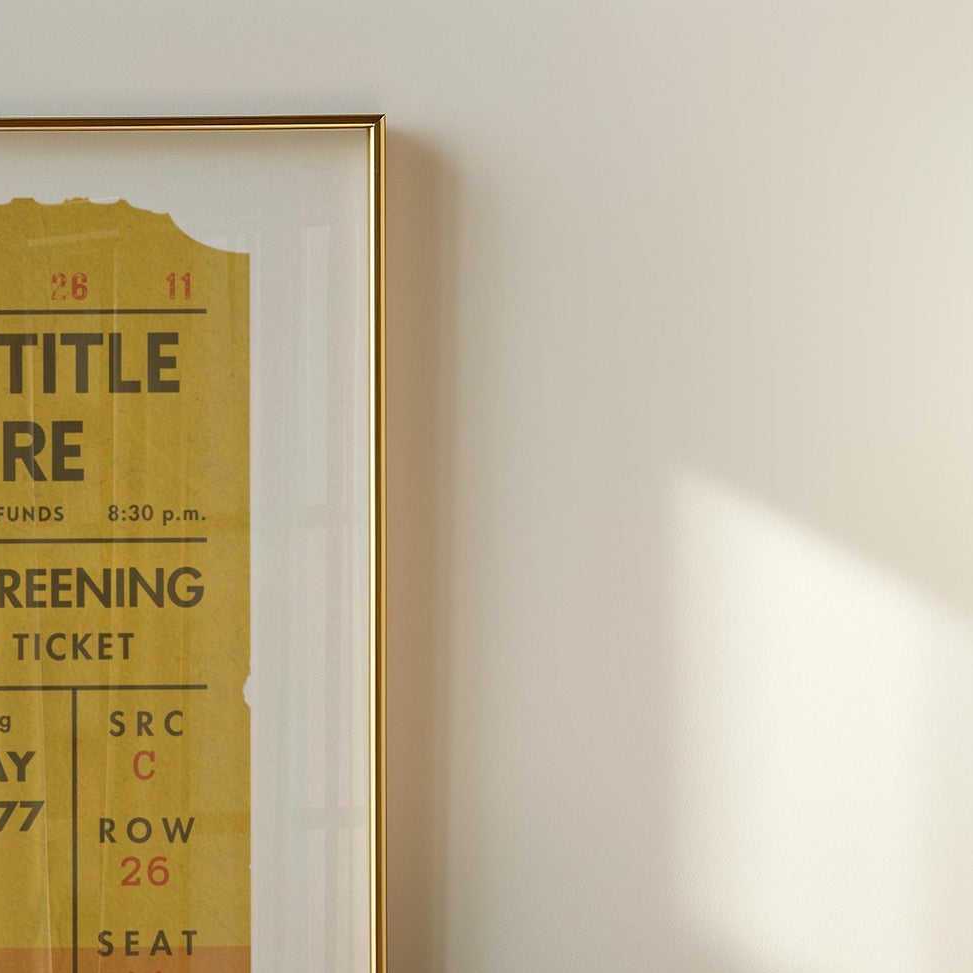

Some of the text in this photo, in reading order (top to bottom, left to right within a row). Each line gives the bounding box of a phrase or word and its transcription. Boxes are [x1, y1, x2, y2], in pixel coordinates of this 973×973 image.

[52, 273, 87, 300] 26
[168, 273, 191, 299] 11
[108, 505, 205, 526] 8:30 p.m.
[13, 633, 134, 661] TICKET
[110, 710, 183, 737] SRC
[133, 750, 156, 780] C
[100, 817, 194, 843] ROW
[121, 856, 169, 886] 26
[98, 930, 197, 957] SEAT
